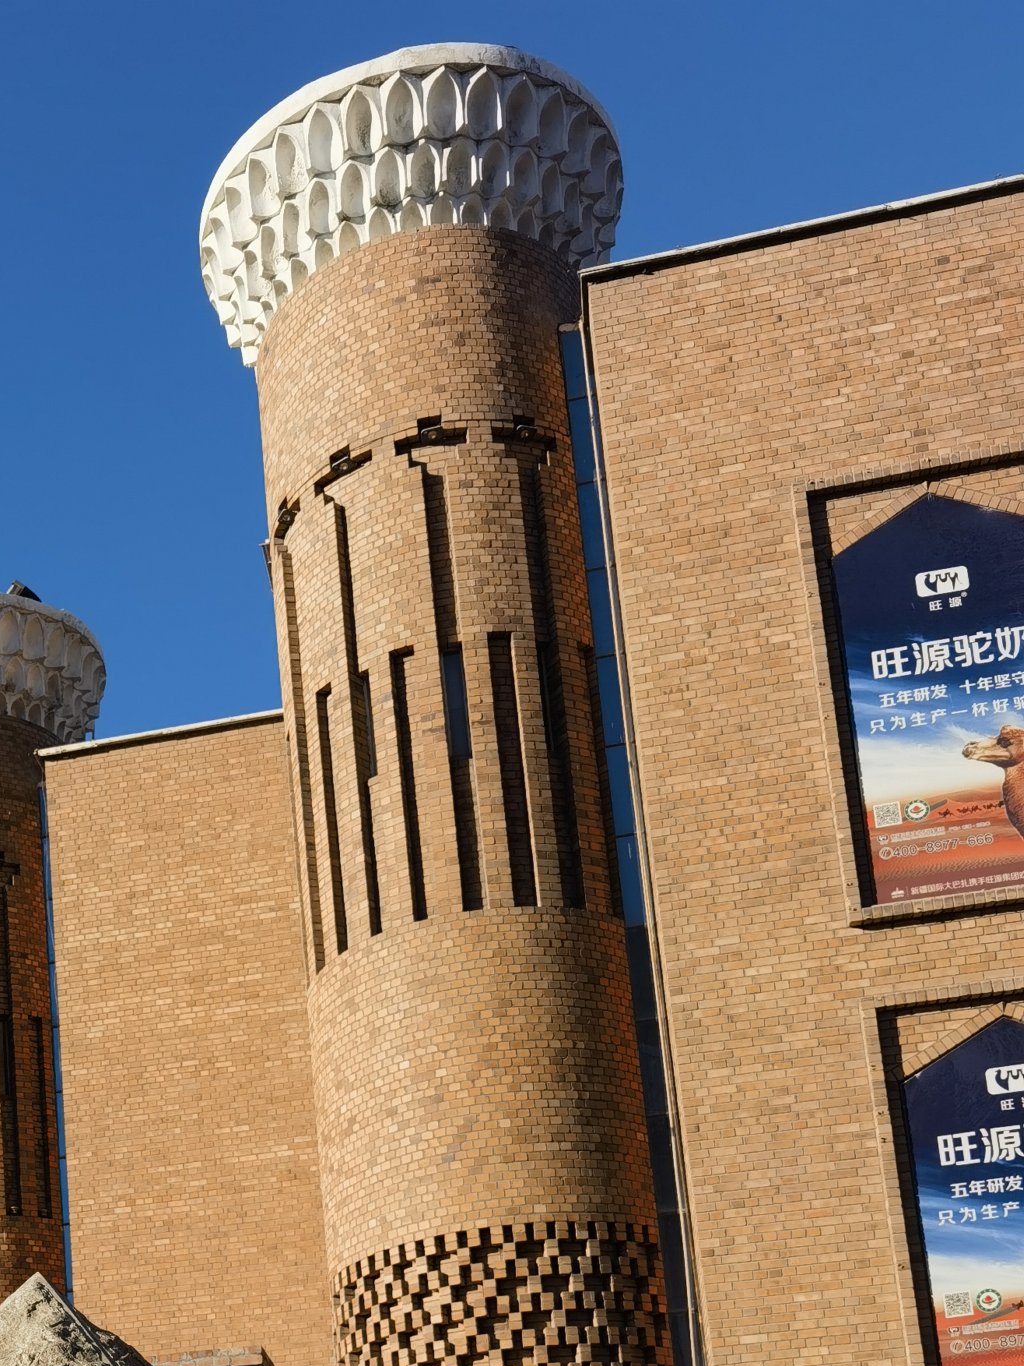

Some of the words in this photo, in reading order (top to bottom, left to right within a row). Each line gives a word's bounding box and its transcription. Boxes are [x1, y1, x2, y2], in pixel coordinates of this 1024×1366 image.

[871, 626, 1024, 680] 旺源驼奶
[879, 684, 949, 708] 五年研发
[892, 834, 993, 858] 400-8977-666
[937, 1125, 1024, 1167] 旺源
[950, 1175, 1024, 1199] 五年研发
[938, 1201, 1020, 1226] 只为生产
